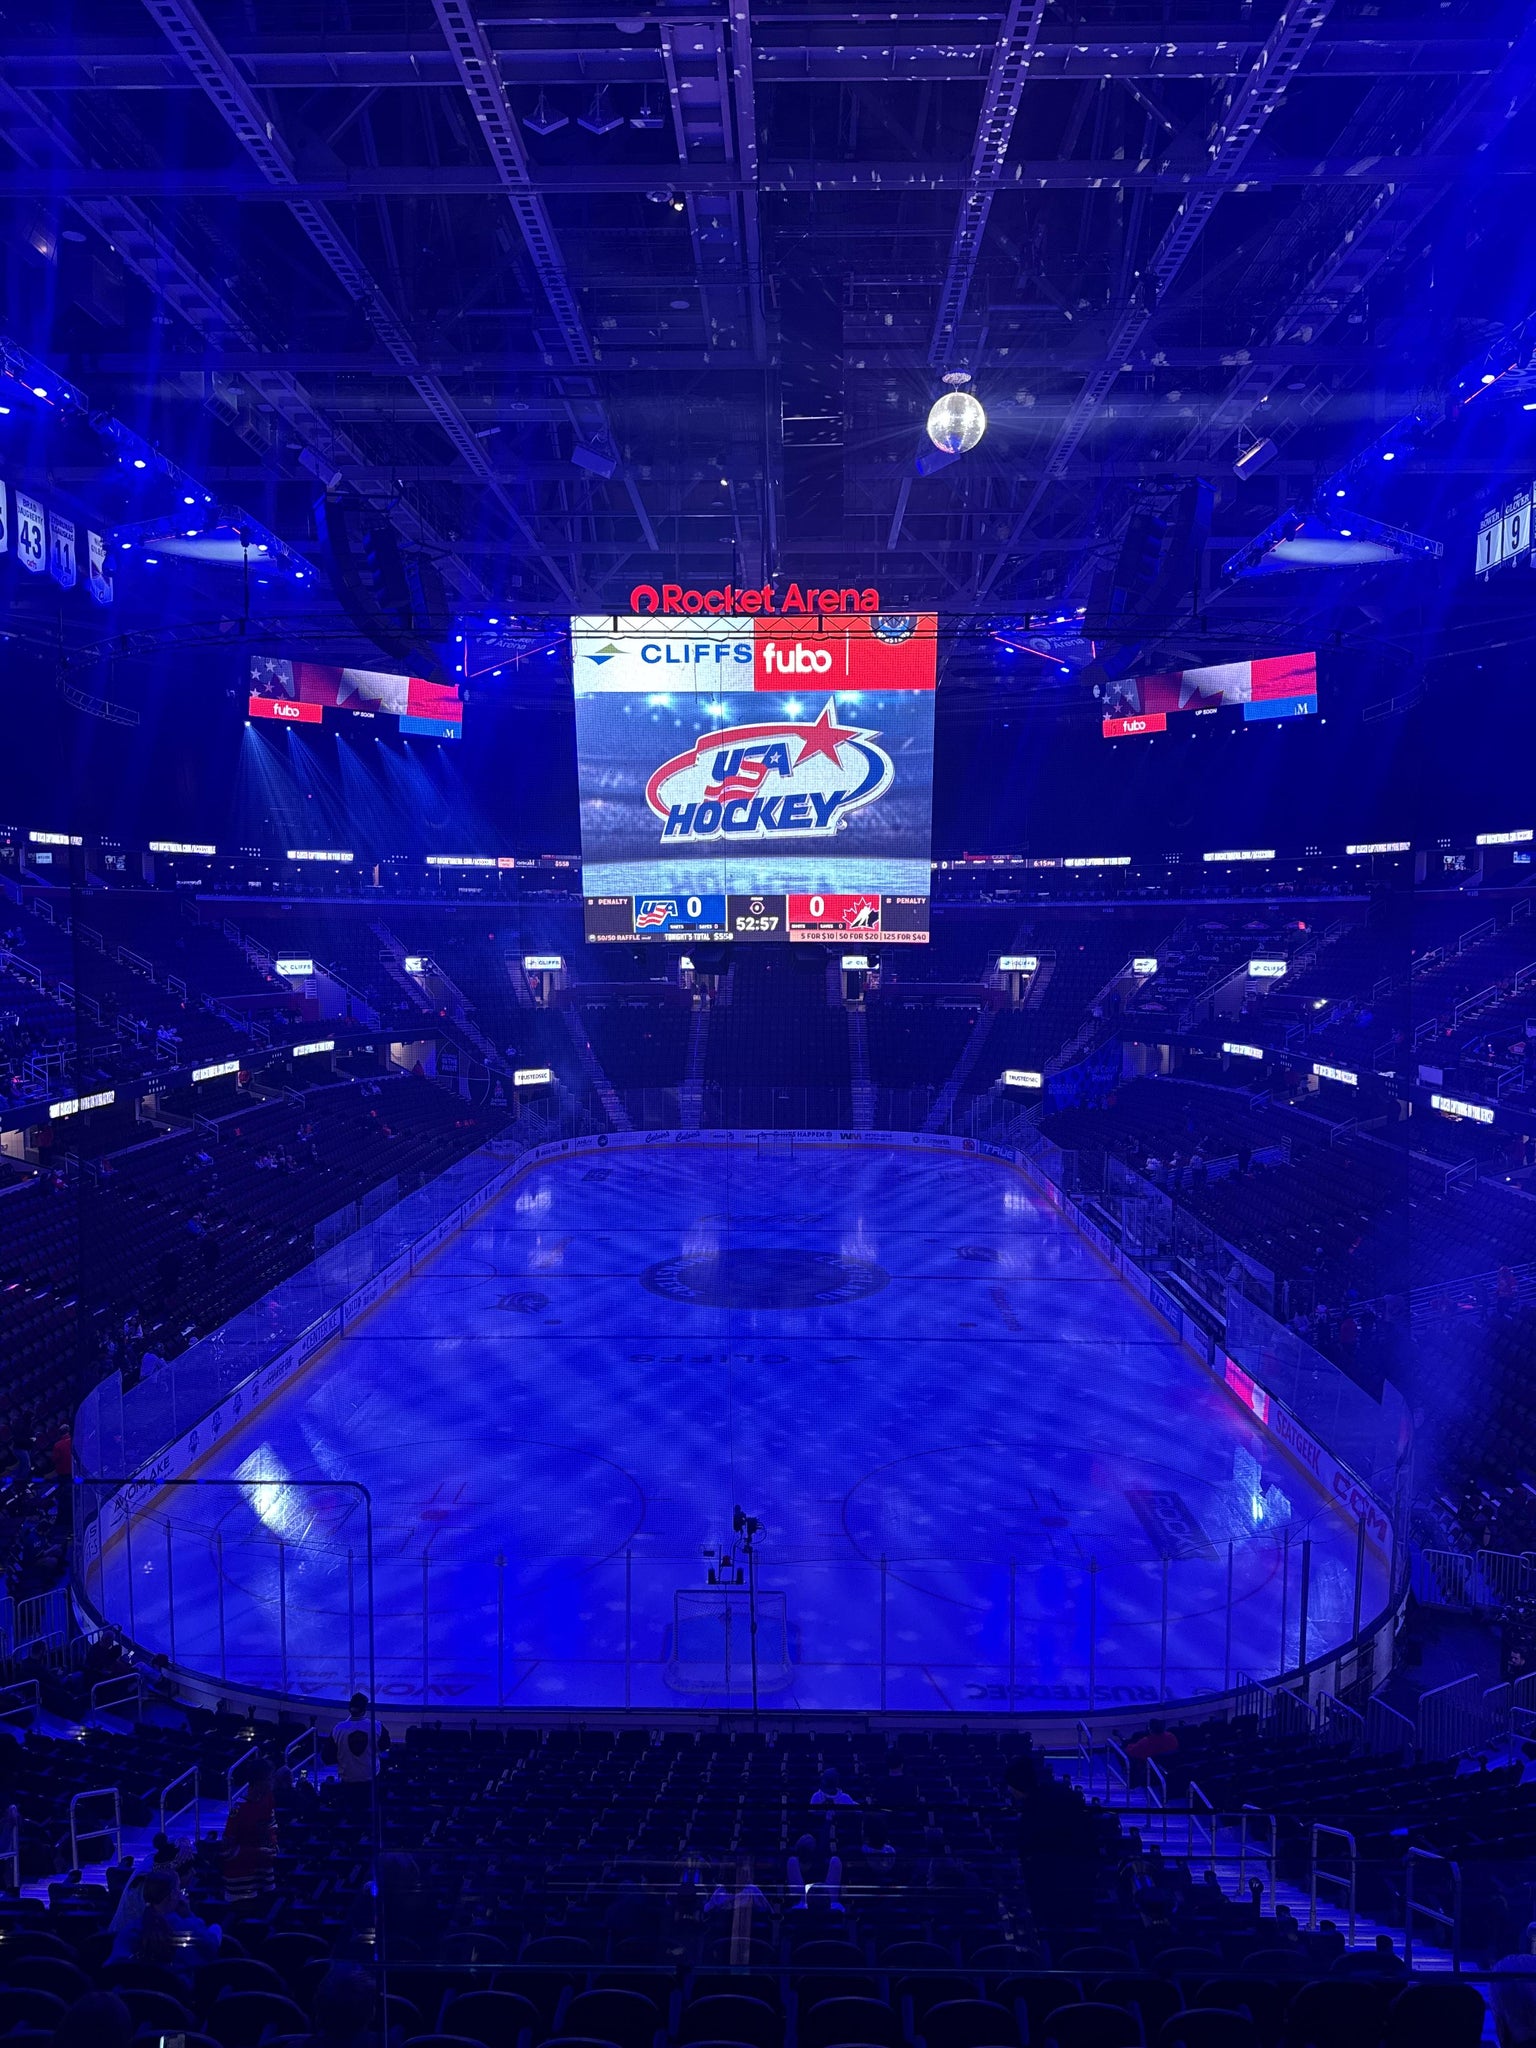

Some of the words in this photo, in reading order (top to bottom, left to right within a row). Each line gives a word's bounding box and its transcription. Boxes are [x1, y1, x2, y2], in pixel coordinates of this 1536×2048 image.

[22, 498, 37, 512] BRAD
[1505, 494, 1529, 515] GLOVER
[20, 519, 42, 561] 43
[1511, 515, 1521, 550] 9
[54, 540, 71, 574] 11
[1486, 530, 1492, 564] 1
[662, 584, 775, 613] Rocket
[782, 583, 880, 613] Arena
[640, 643, 753, 664] CLIFFS
[763, 643, 833, 674] fubo
[273, 703, 300, 717] fubo
[1123, 720, 1146, 732] fubo
[704, 742, 794, 802] USA
[664, 790, 843, 836] HOCKEY
[636, 900, 679, 928] USA
[686, 896, 703, 918] 0
[809, 895, 825, 917] 0
[735, 916, 779, 932] 52:57
[517, 1072, 548, 1080] TRUSTEDSEC
[983, 1142, 1015, 1160] TRUE
[1152, 1292, 1178, 1320] TRUE
[1276, 1410, 1322, 1477] SEATGEEK
[1333, 1471, 1387, 1542] CCM
